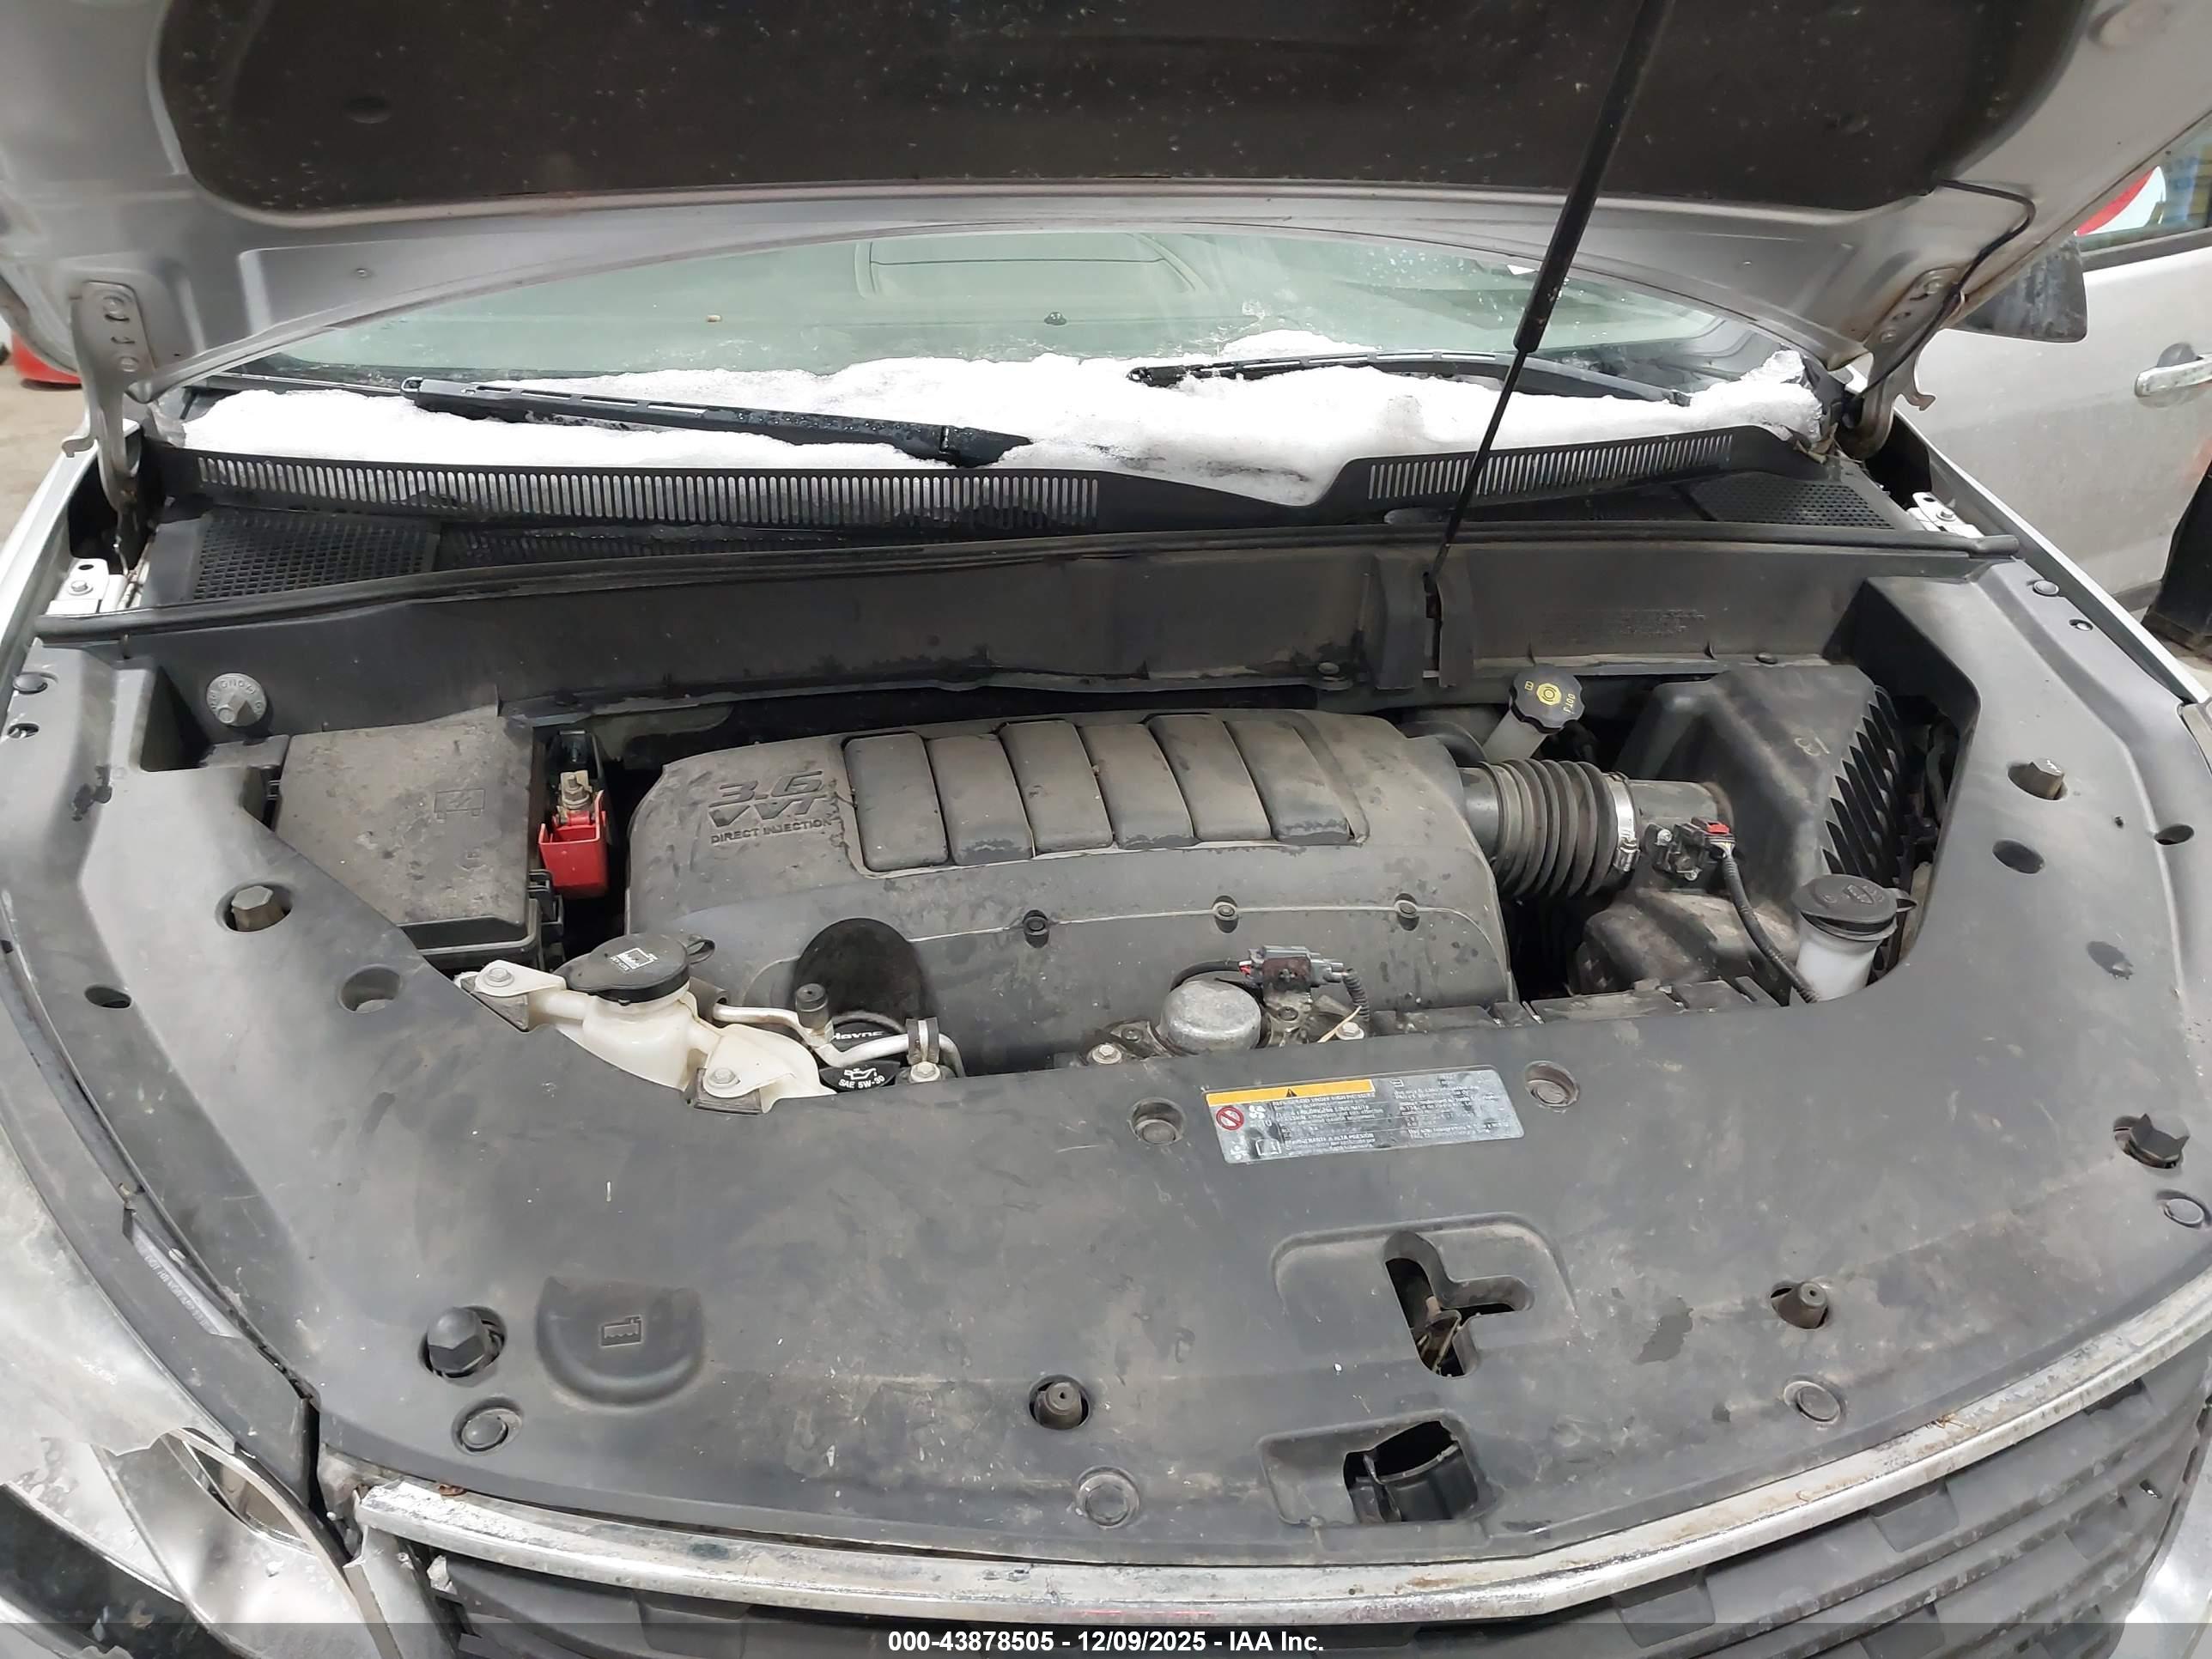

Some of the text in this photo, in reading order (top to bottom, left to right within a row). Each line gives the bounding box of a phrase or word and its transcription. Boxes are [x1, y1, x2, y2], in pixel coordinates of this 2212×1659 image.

[708, 770, 823, 808] 3.6
[711, 817, 832, 844] DIRECT INJECTION
[838, 1075, 885, 1089] SAE 5W-30
